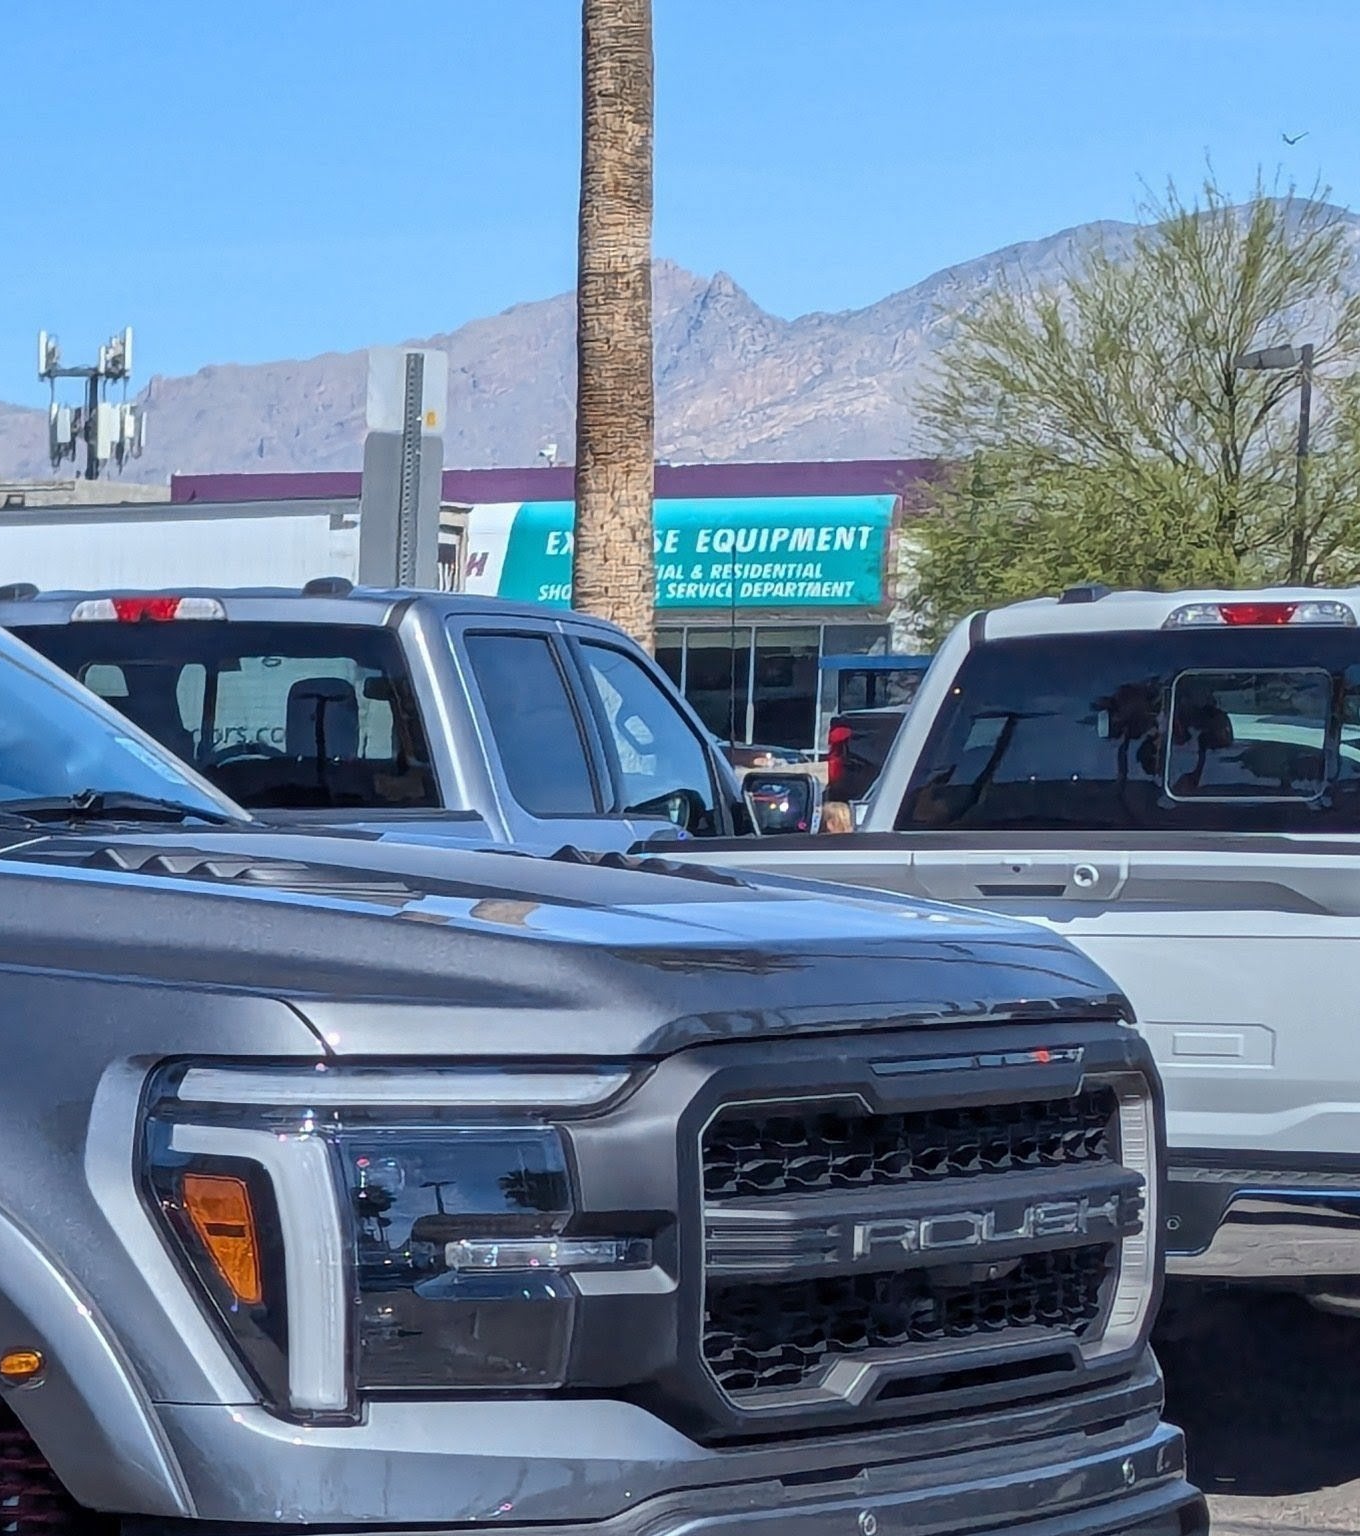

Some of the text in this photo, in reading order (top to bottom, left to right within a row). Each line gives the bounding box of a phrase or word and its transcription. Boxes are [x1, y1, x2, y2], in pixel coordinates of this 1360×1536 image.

[696, 526, 874, 553] EQUIPMENT
[690, 565, 703, 580] &
[710, 563, 823, 580] RESIDENTIAL
[740, 581, 855, 598] DEPARTMENT
[852, 1193, 1120, 1262] ROUSH
